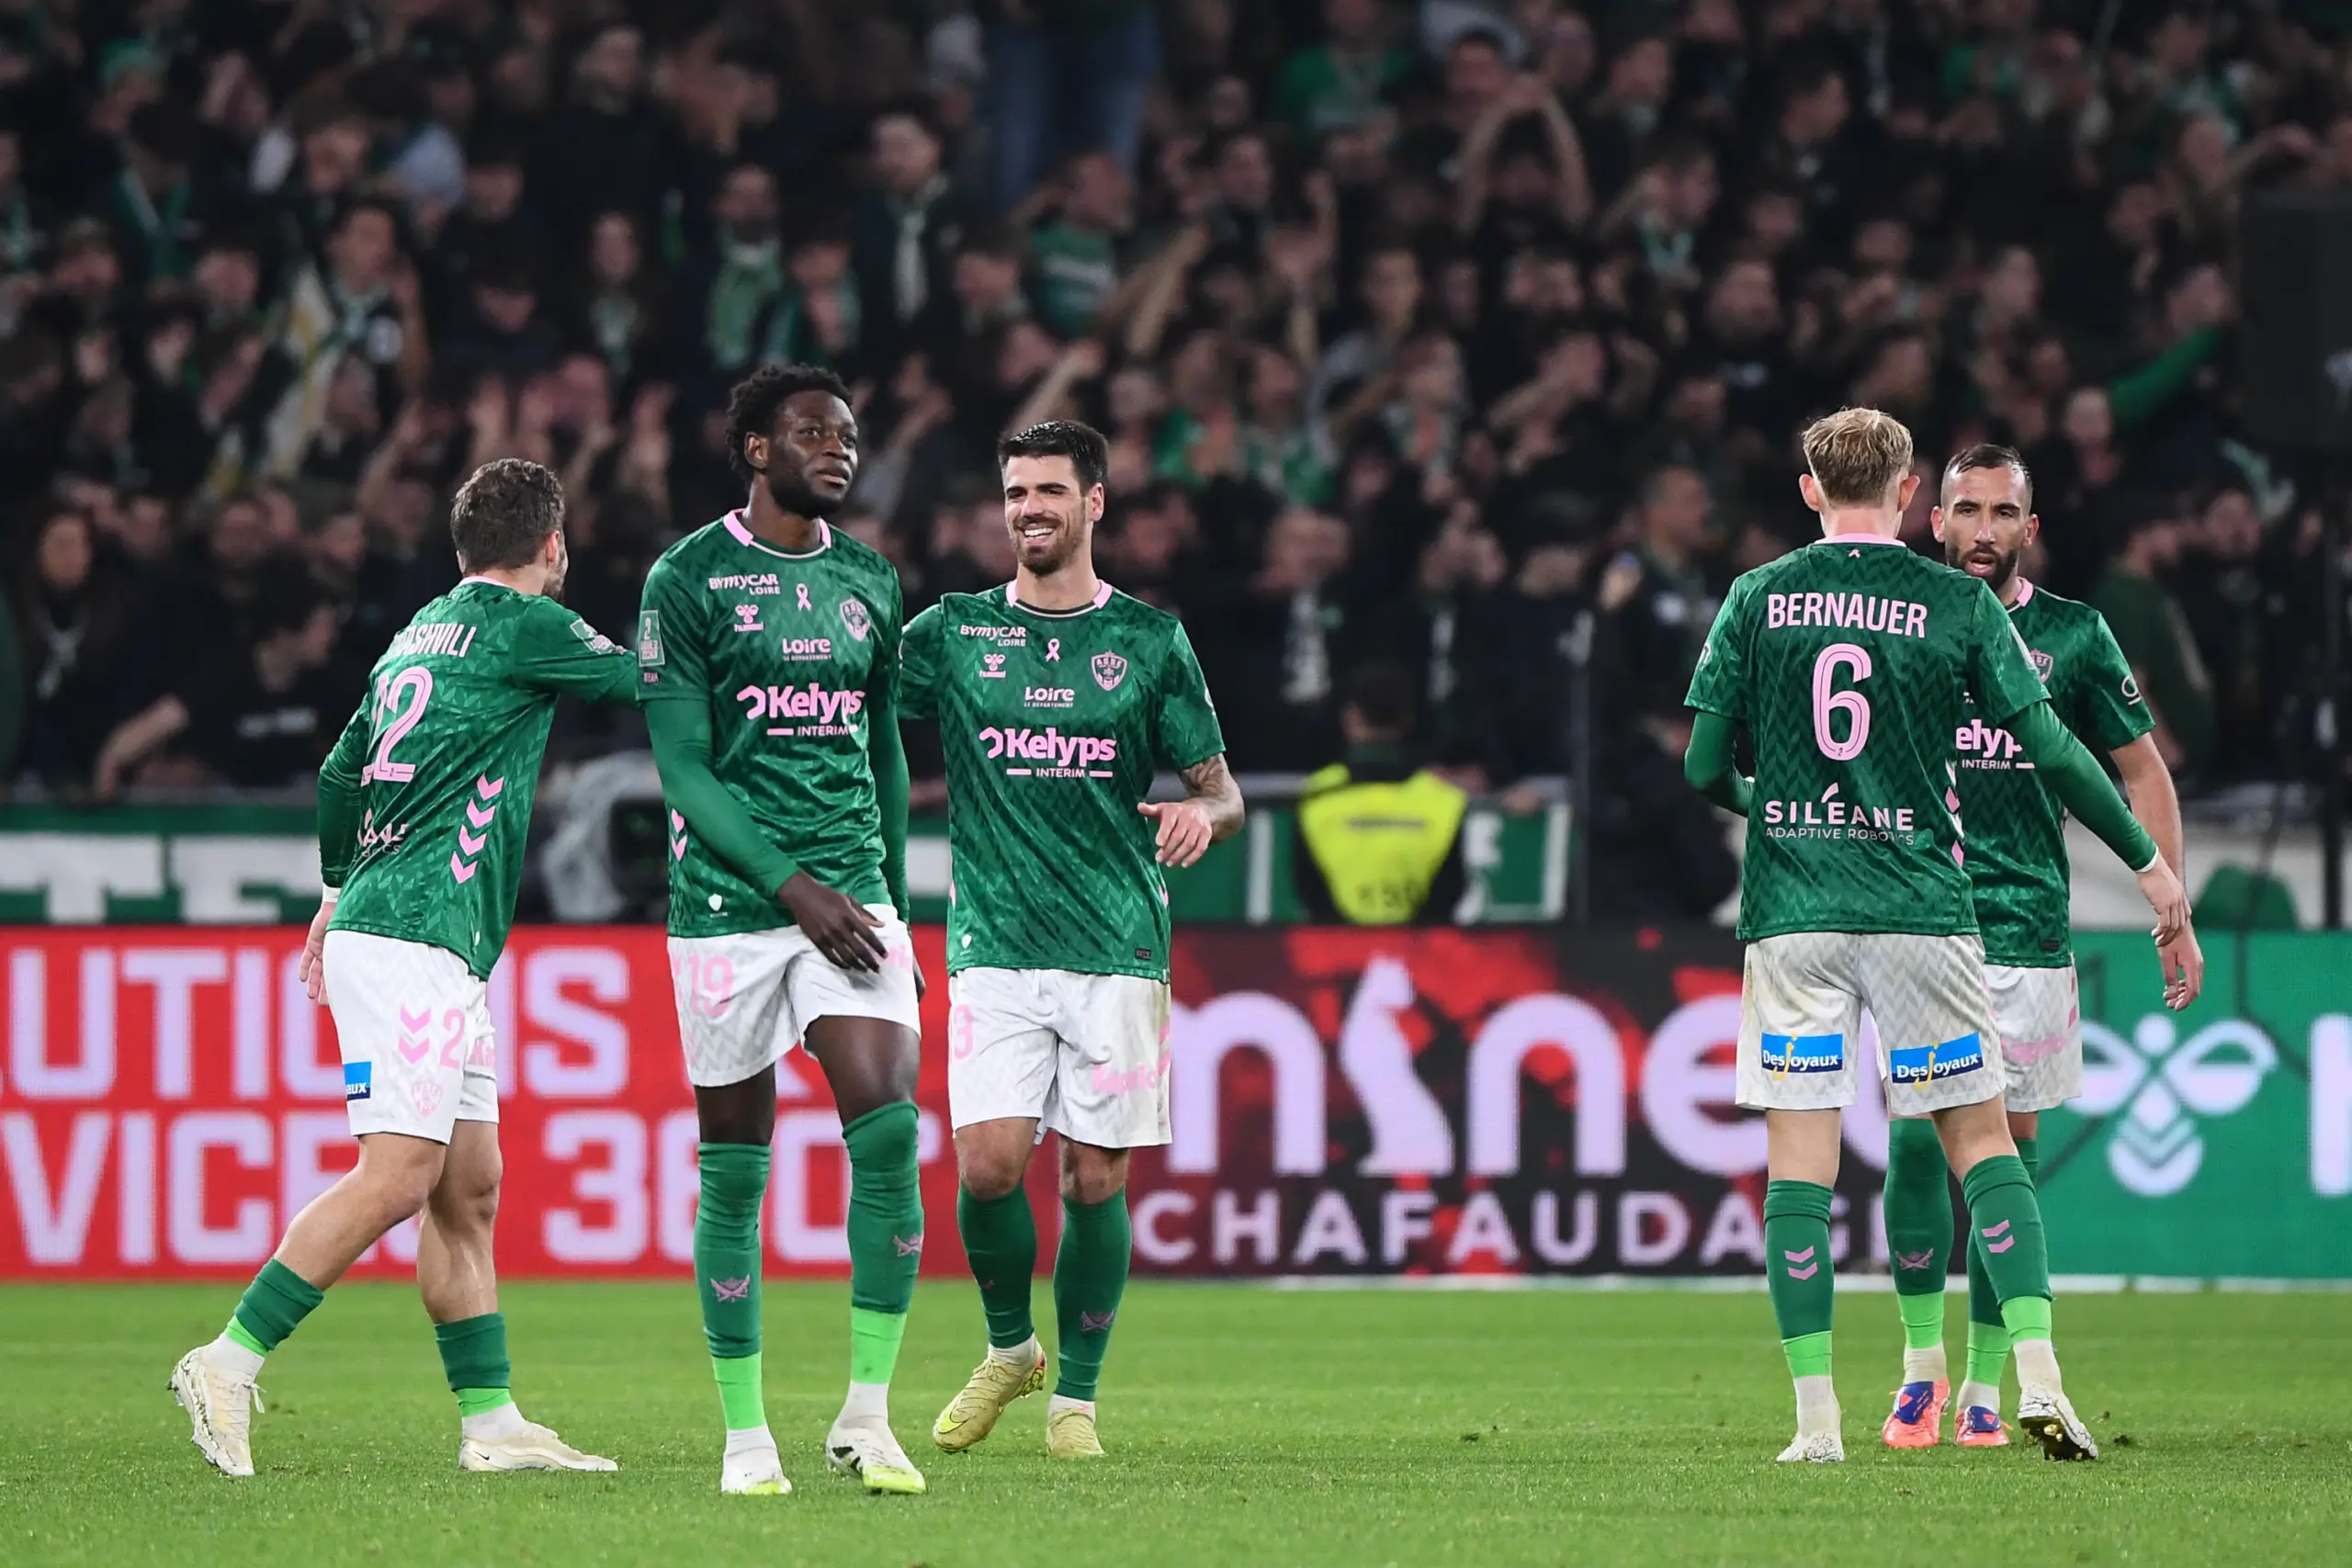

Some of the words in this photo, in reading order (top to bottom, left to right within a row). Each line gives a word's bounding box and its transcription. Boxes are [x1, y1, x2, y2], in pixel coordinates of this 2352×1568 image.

[749, 585, 781, 595] LOIRE
[1767, 592, 1928, 638] BERNAUER
[783, 637, 831, 653] Loire
[997, 638, 1026, 647] LOIRE
[767, 682, 865, 724] Kelyps
[1024, 686, 1074, 701] Loire
[1813, 643, 1872, 761] 6
[797, 725, 849, 737] INTERIM
[1955, 718, 2022, 759] elyp
[1005, 728, 1116, 766] Kelyps
[1035, 768, 1085, 778] INTERIM
[1962, 759, 2011, 770] INTERIM
[1766, 828, 1842, 840] ADAPTIVE
[689, 955, 733, 1018] 19
[1763, 1033, 1838, 1080] Desjoyaux
[1895, 1042, 1979, 1090] Desjoyaux
